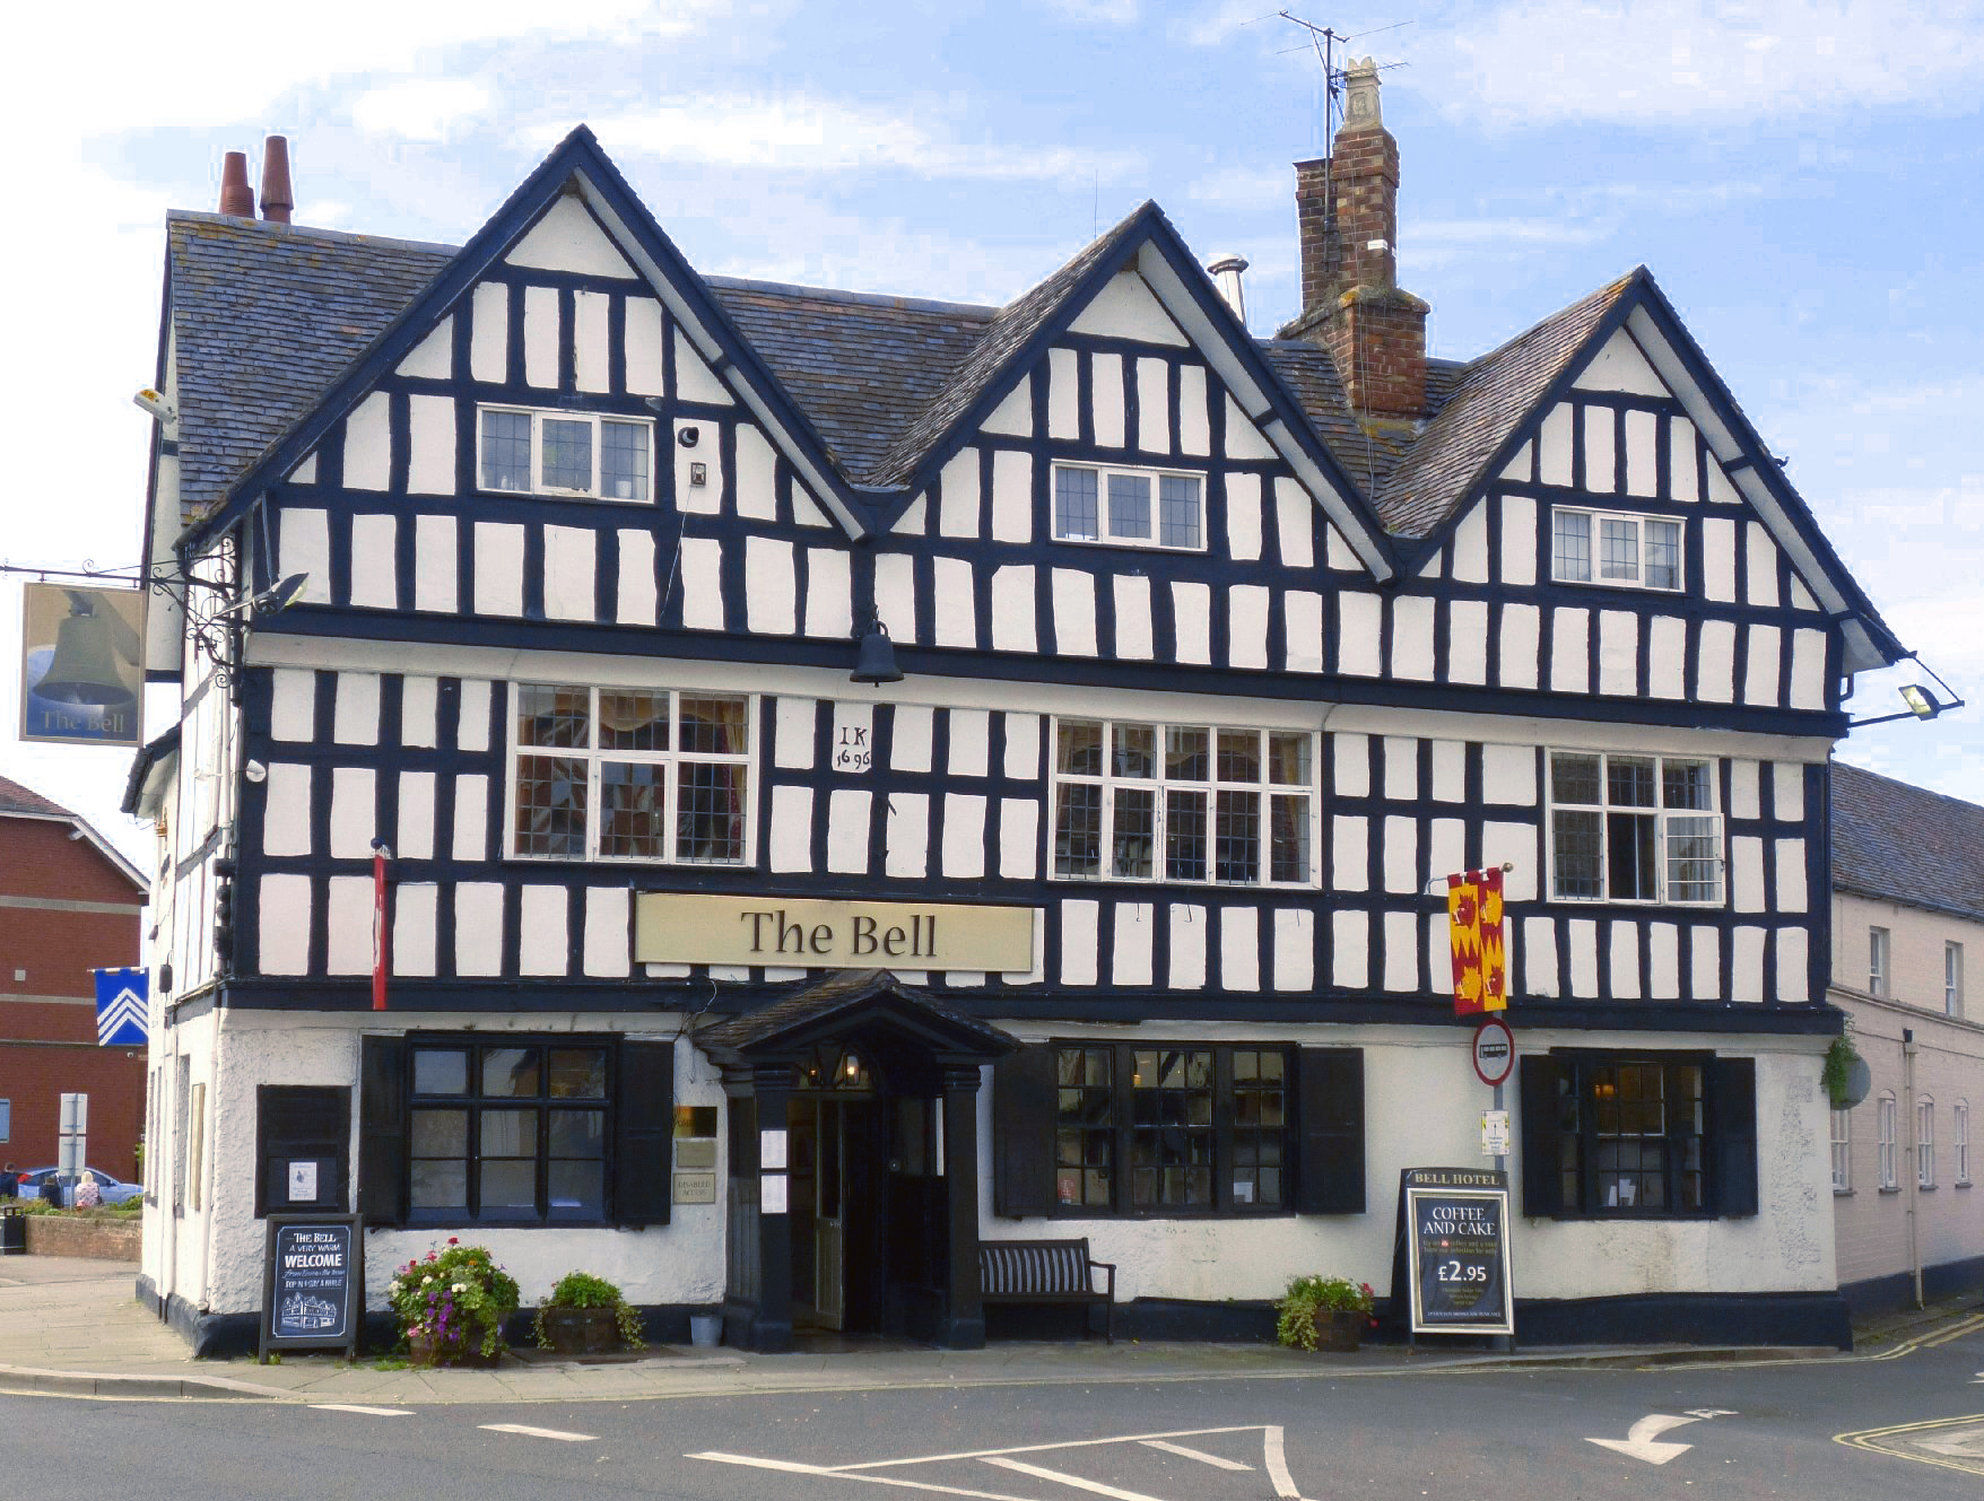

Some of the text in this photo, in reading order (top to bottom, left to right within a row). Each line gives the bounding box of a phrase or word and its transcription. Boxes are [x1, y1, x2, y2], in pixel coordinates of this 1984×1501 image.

[42, 710, 123, 733] The Bell
[853, 727, 867, 747] K
[837, 749, 870, 769] 1696
[741, 910, 937, 957] The Bell
[1415, 1173, 1500, 1185] BELL HOTEL
[1432, 1207, 1485, 1220] COFFEE
[1423, 1221, 1496, 1236] AND CAKE
[294, 1232, 337, 1243] THE BELL
[285, 1254, 342, 1268] WELCOME
[1438, 1260, 1487, 1282] £2.95
